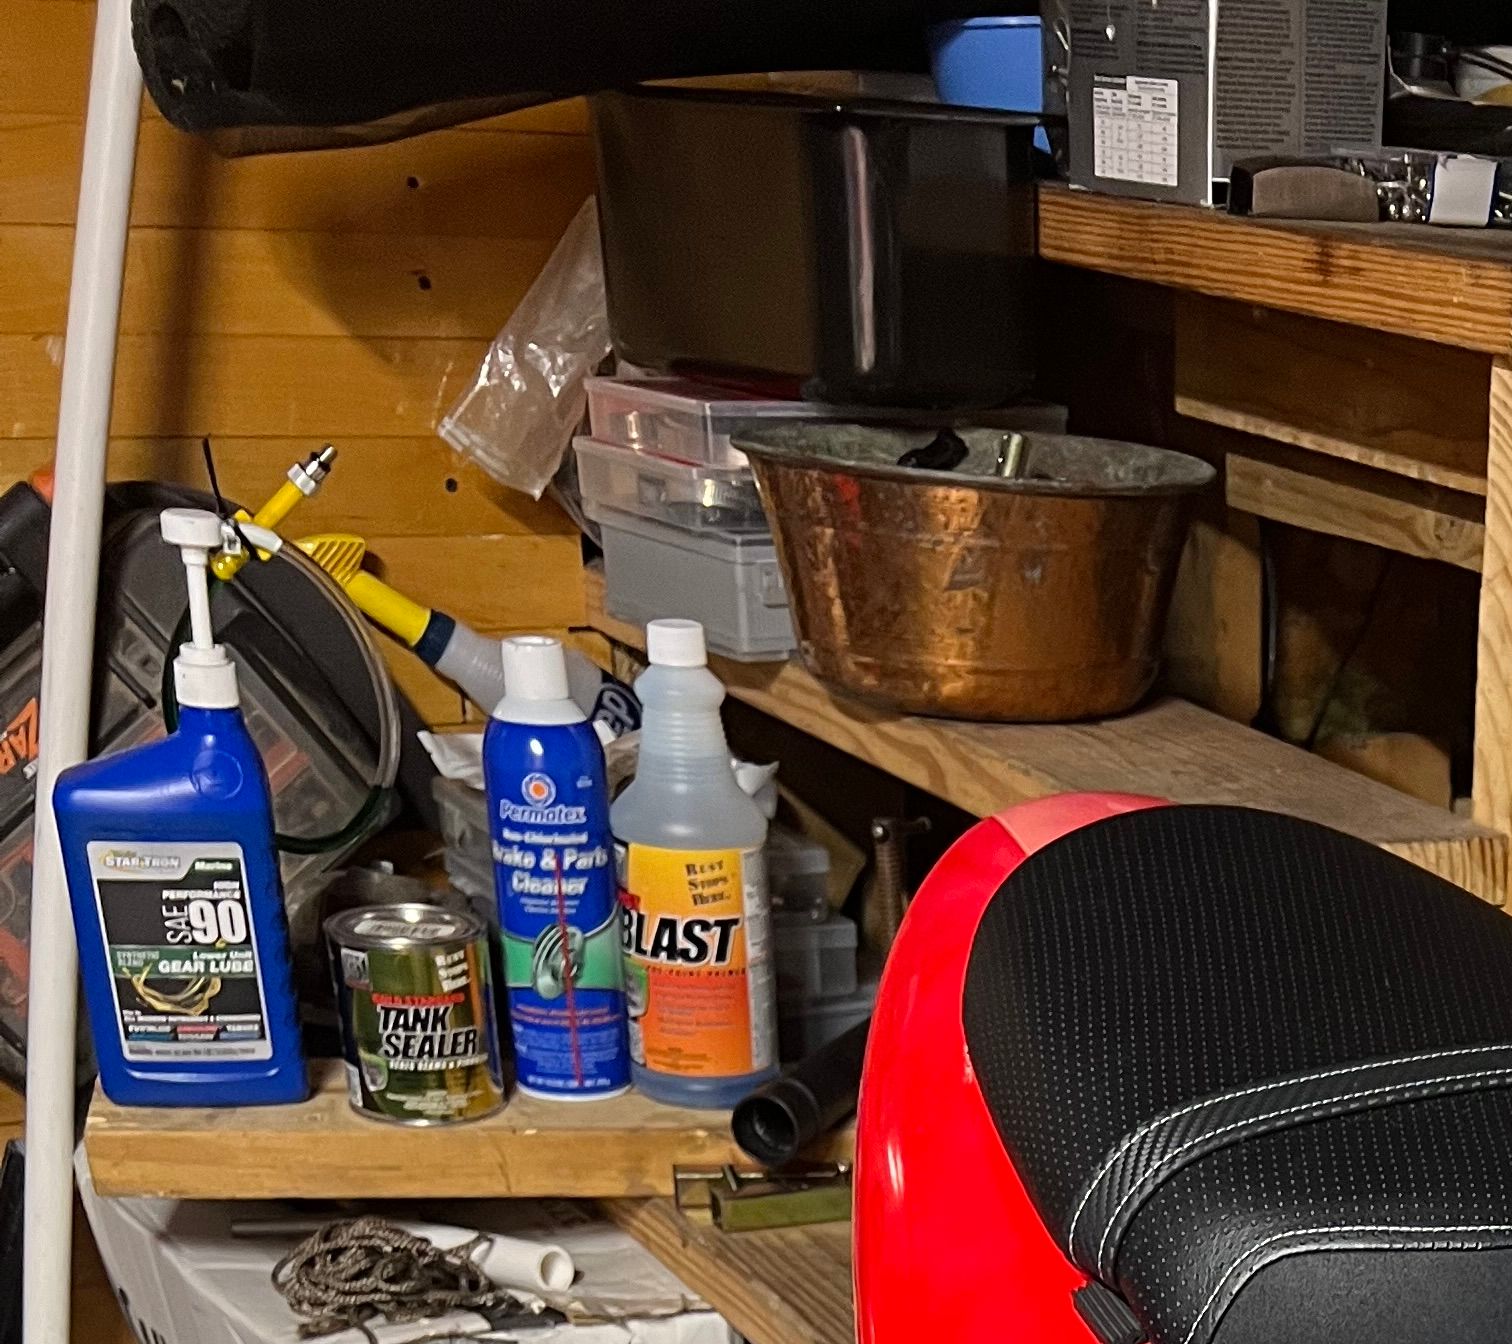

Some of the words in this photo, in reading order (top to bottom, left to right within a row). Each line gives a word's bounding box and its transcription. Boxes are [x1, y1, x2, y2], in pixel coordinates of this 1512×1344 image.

[500, 798, 587, 825] Permatex
[161, 904, 193, 944] SAE
[188, 899, 247, 945] 90
[621, 906, 741, 964] BLAST
[158, 959, 206, 974] GEAR
[377, 1003, 453, 1035] TANK
[382, 1026, 478, 1060] SEALER
